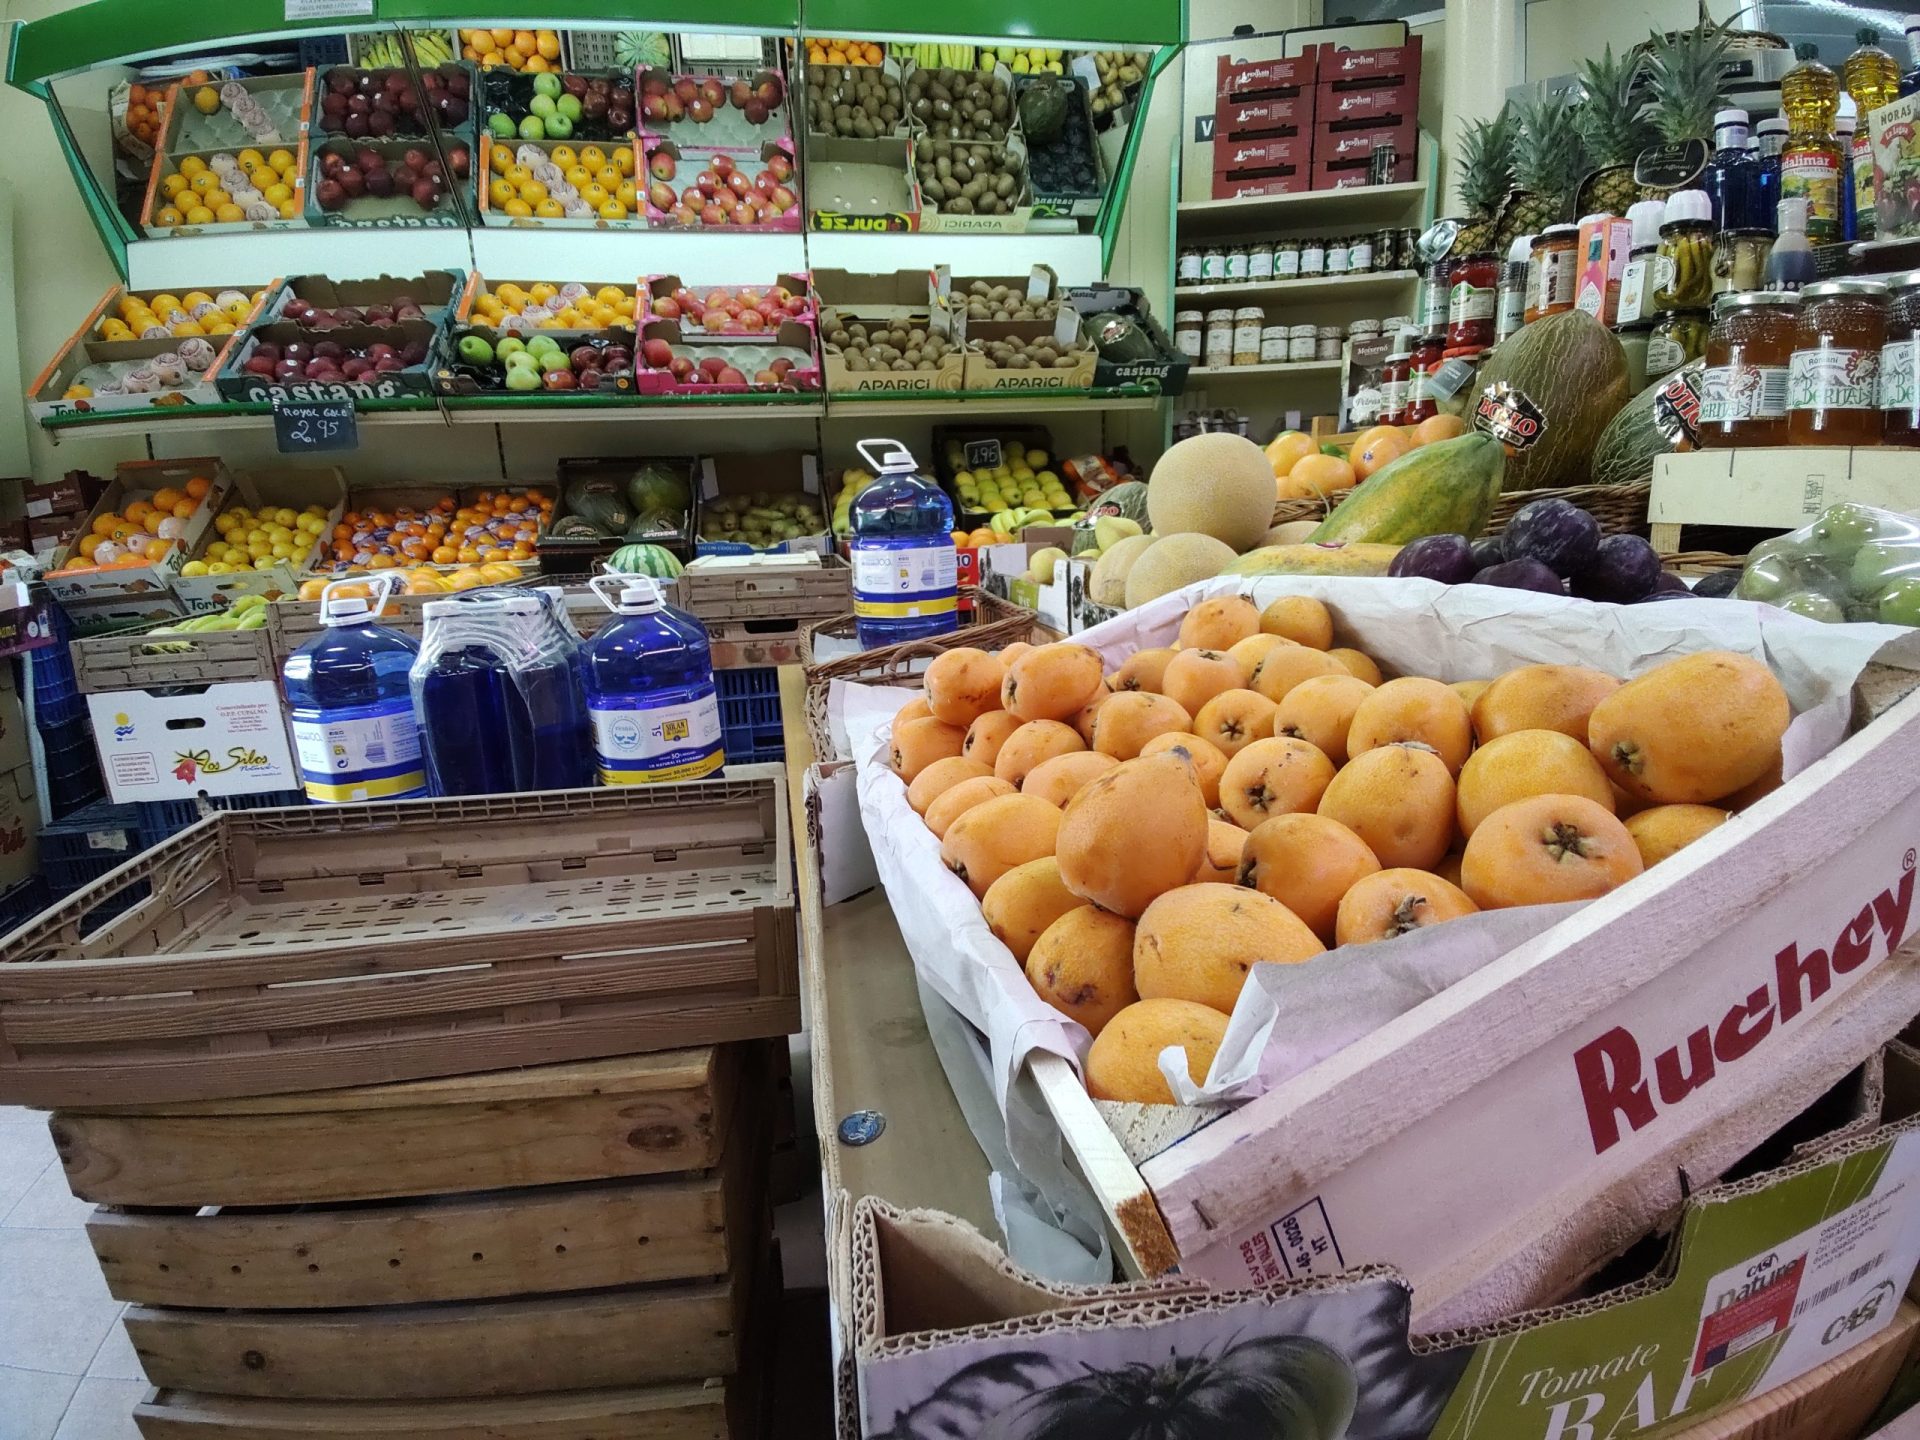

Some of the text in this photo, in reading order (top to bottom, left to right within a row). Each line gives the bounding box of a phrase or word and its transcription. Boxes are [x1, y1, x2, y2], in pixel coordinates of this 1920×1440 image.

[1115, 365, 1170, 378] castang
[222, 746, 268, 772] Silos
[1573, 866, 1916, 1155] Ruchey
[1311, 1236, 1328, 1255] HT
[1746, 1254, 1775, 1279] CASI
[1820, 1291, 1886, 1347] CASI
[1519, 1342, 1661, 1406] Tomate
